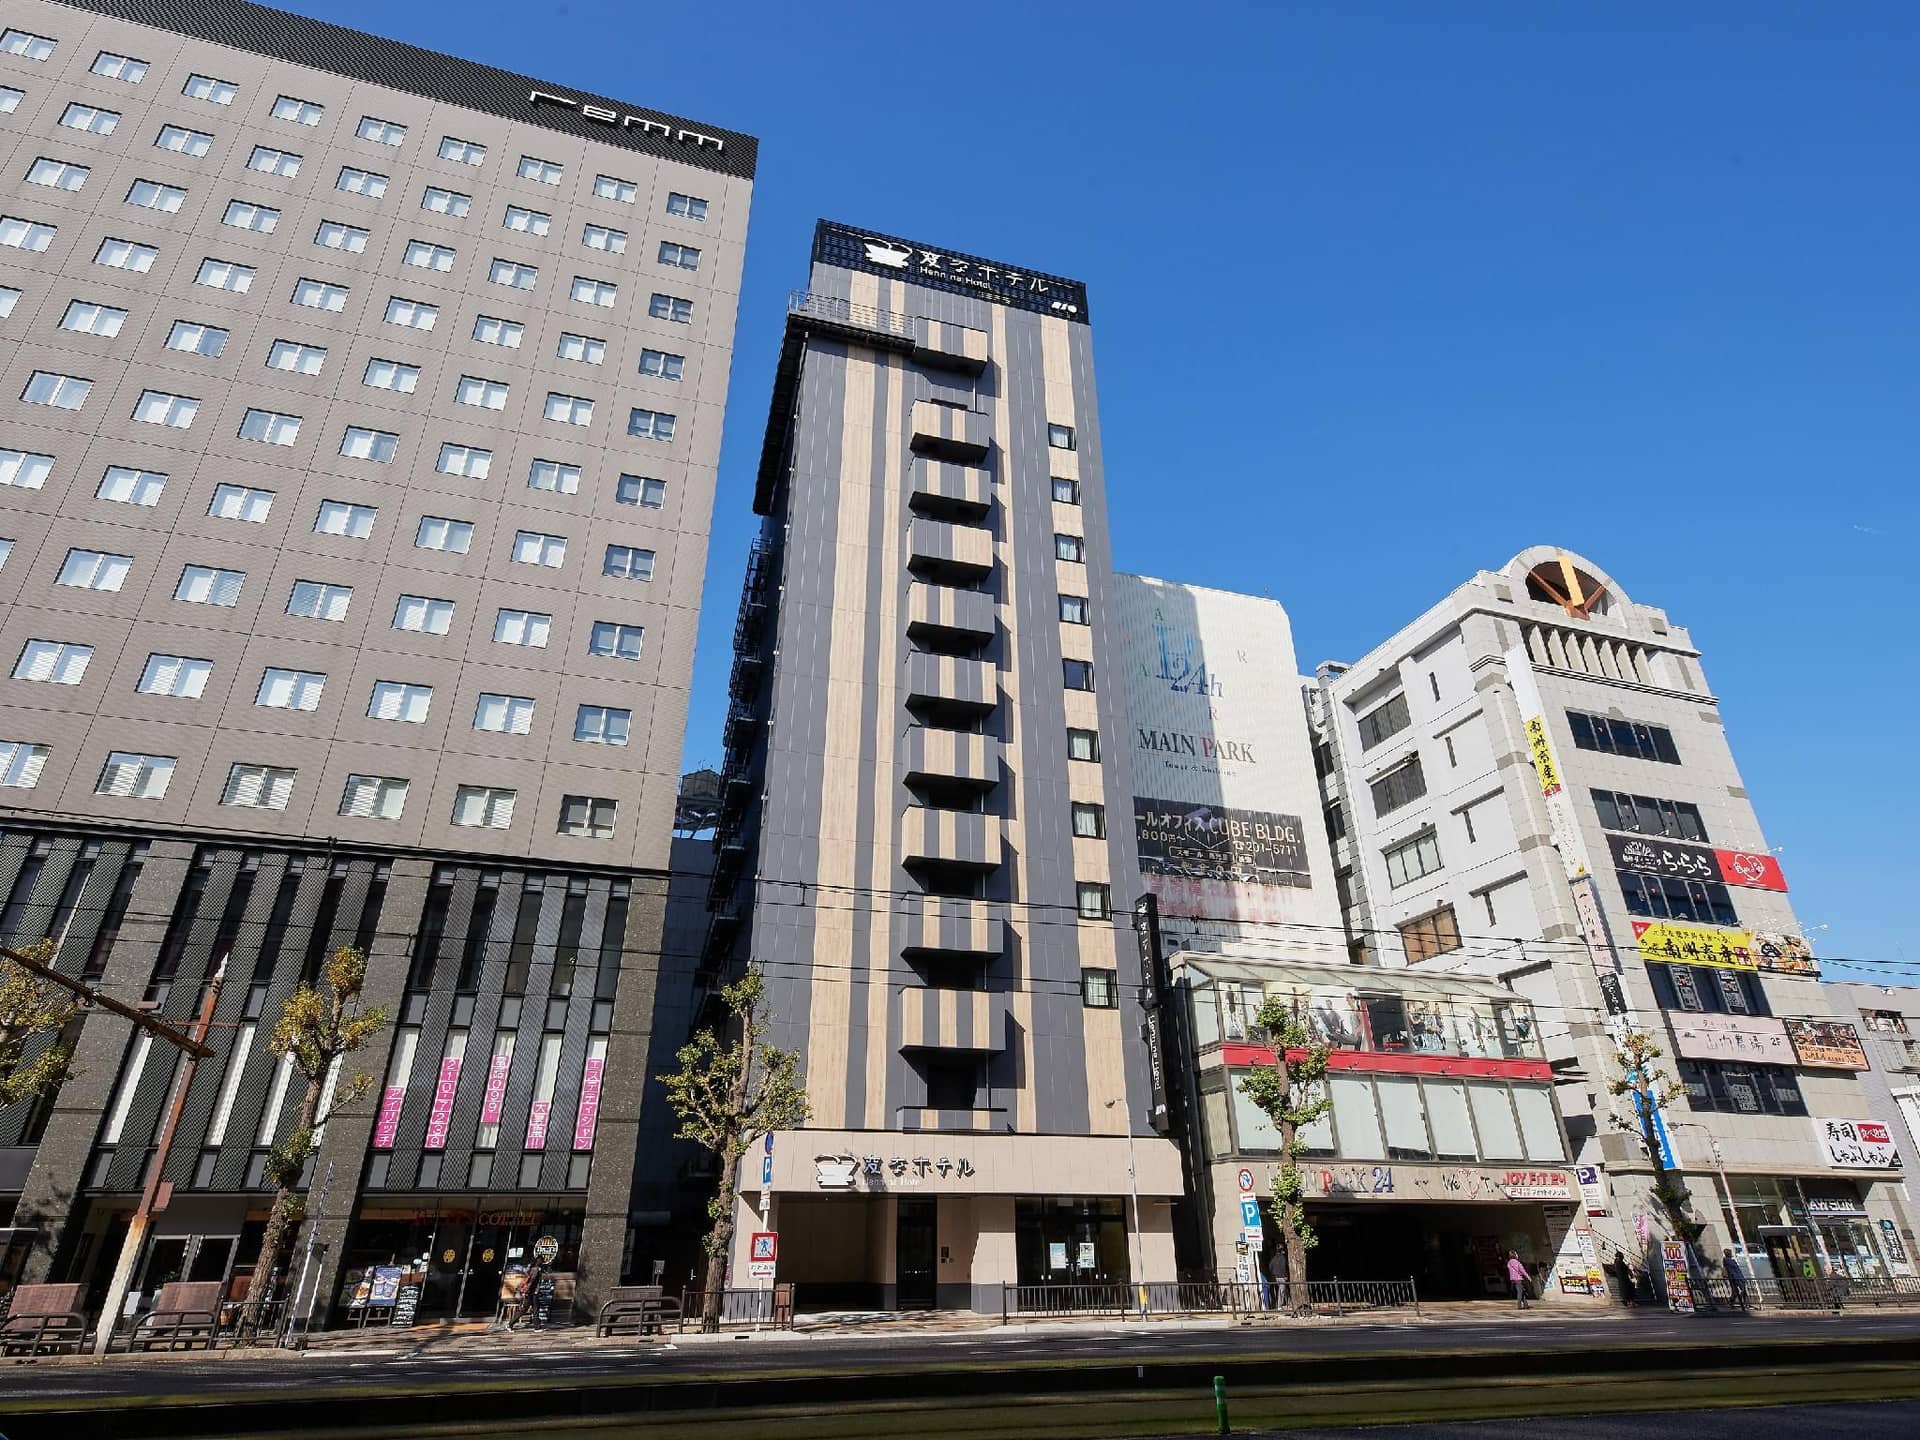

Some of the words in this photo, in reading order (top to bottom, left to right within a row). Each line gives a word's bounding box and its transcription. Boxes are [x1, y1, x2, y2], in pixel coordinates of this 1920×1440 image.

[530, 90, 723, 150] remm
[919, 250, 1049, 293] 変なホテル
[919, 266, 946, 279] Henn
[949, 273, 962, 283] na
[965, 277, 993, 290] Hotel
[1137, 727, 1196, 756] MAIN
[1201, 736, 1256, 763] PARK
[1209, 817, 1251, 838] CUBE
[1255, 823, 1301, 844] BLDG.
[1246, 841, 1299, 857] 201-5711
[577, 1060, 601, 1149] エステティシャン
[379, 1088, 402, 1147] アイリッチ
[1825, 1121, 1857, 1141] 寿司
[863, 1154, 976, 1177] 変なホテル
[1828, 1144, 1890, 1165] しゃぶしゃぶ
[764, 1160, 770, 1181] P
[1372, 1167, 1394, 1193] 24
[1578, 1169, 1589, 1183] P
[1245, 1204, 1256, 1225] P
